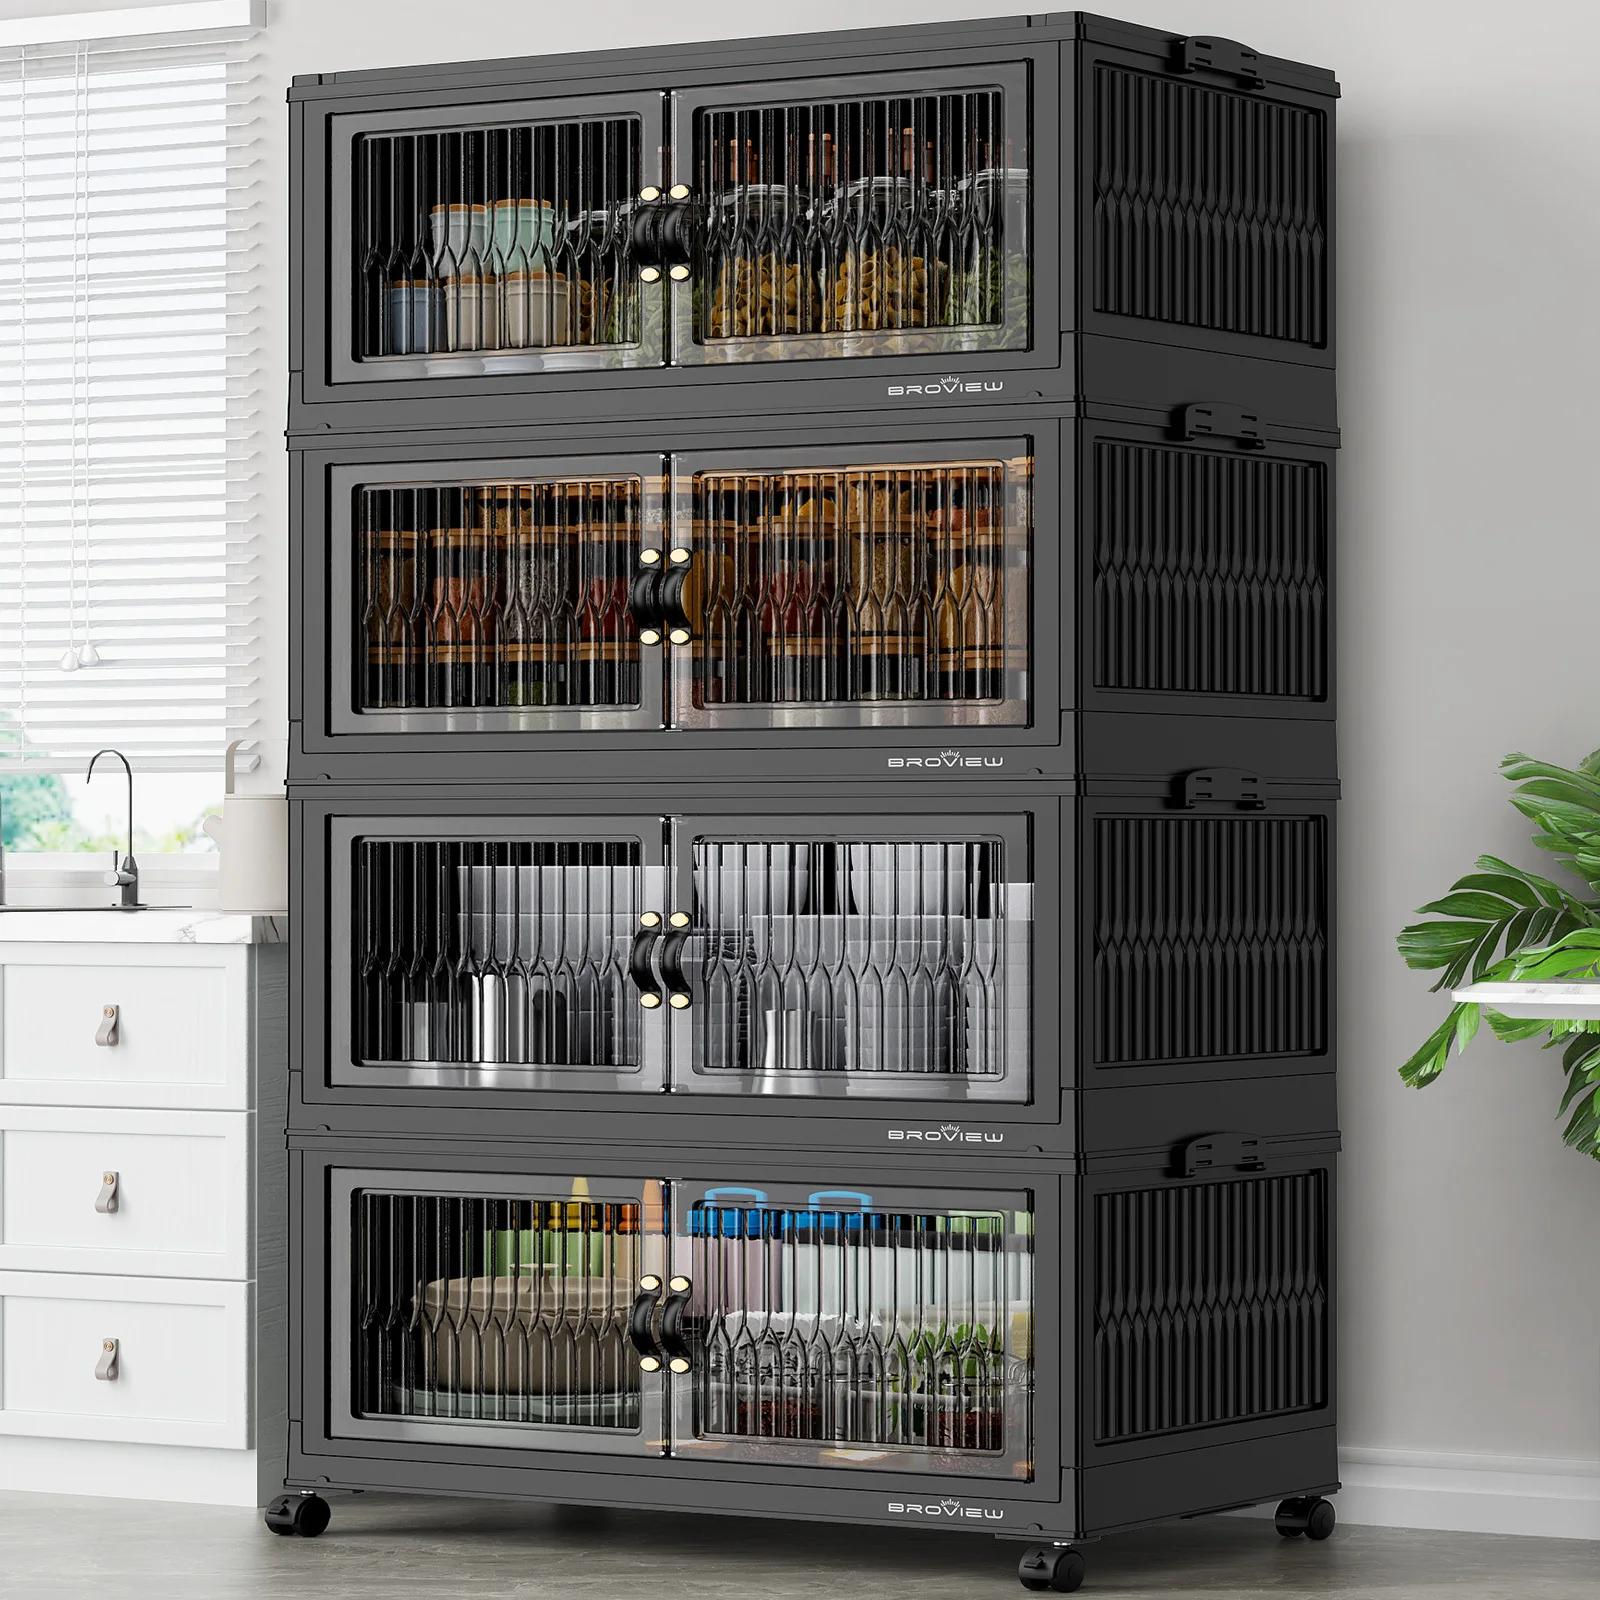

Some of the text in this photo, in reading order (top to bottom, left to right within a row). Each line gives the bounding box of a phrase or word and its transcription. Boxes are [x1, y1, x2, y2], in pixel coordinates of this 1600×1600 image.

[887, 379, 1004, 396] BROVIEW
[887, 755, 1004, 768] BROVIEW
[887, 1128, 1004, 1143] BROVIEW
[887, 1501, 1004, 1520] BROVIEW
